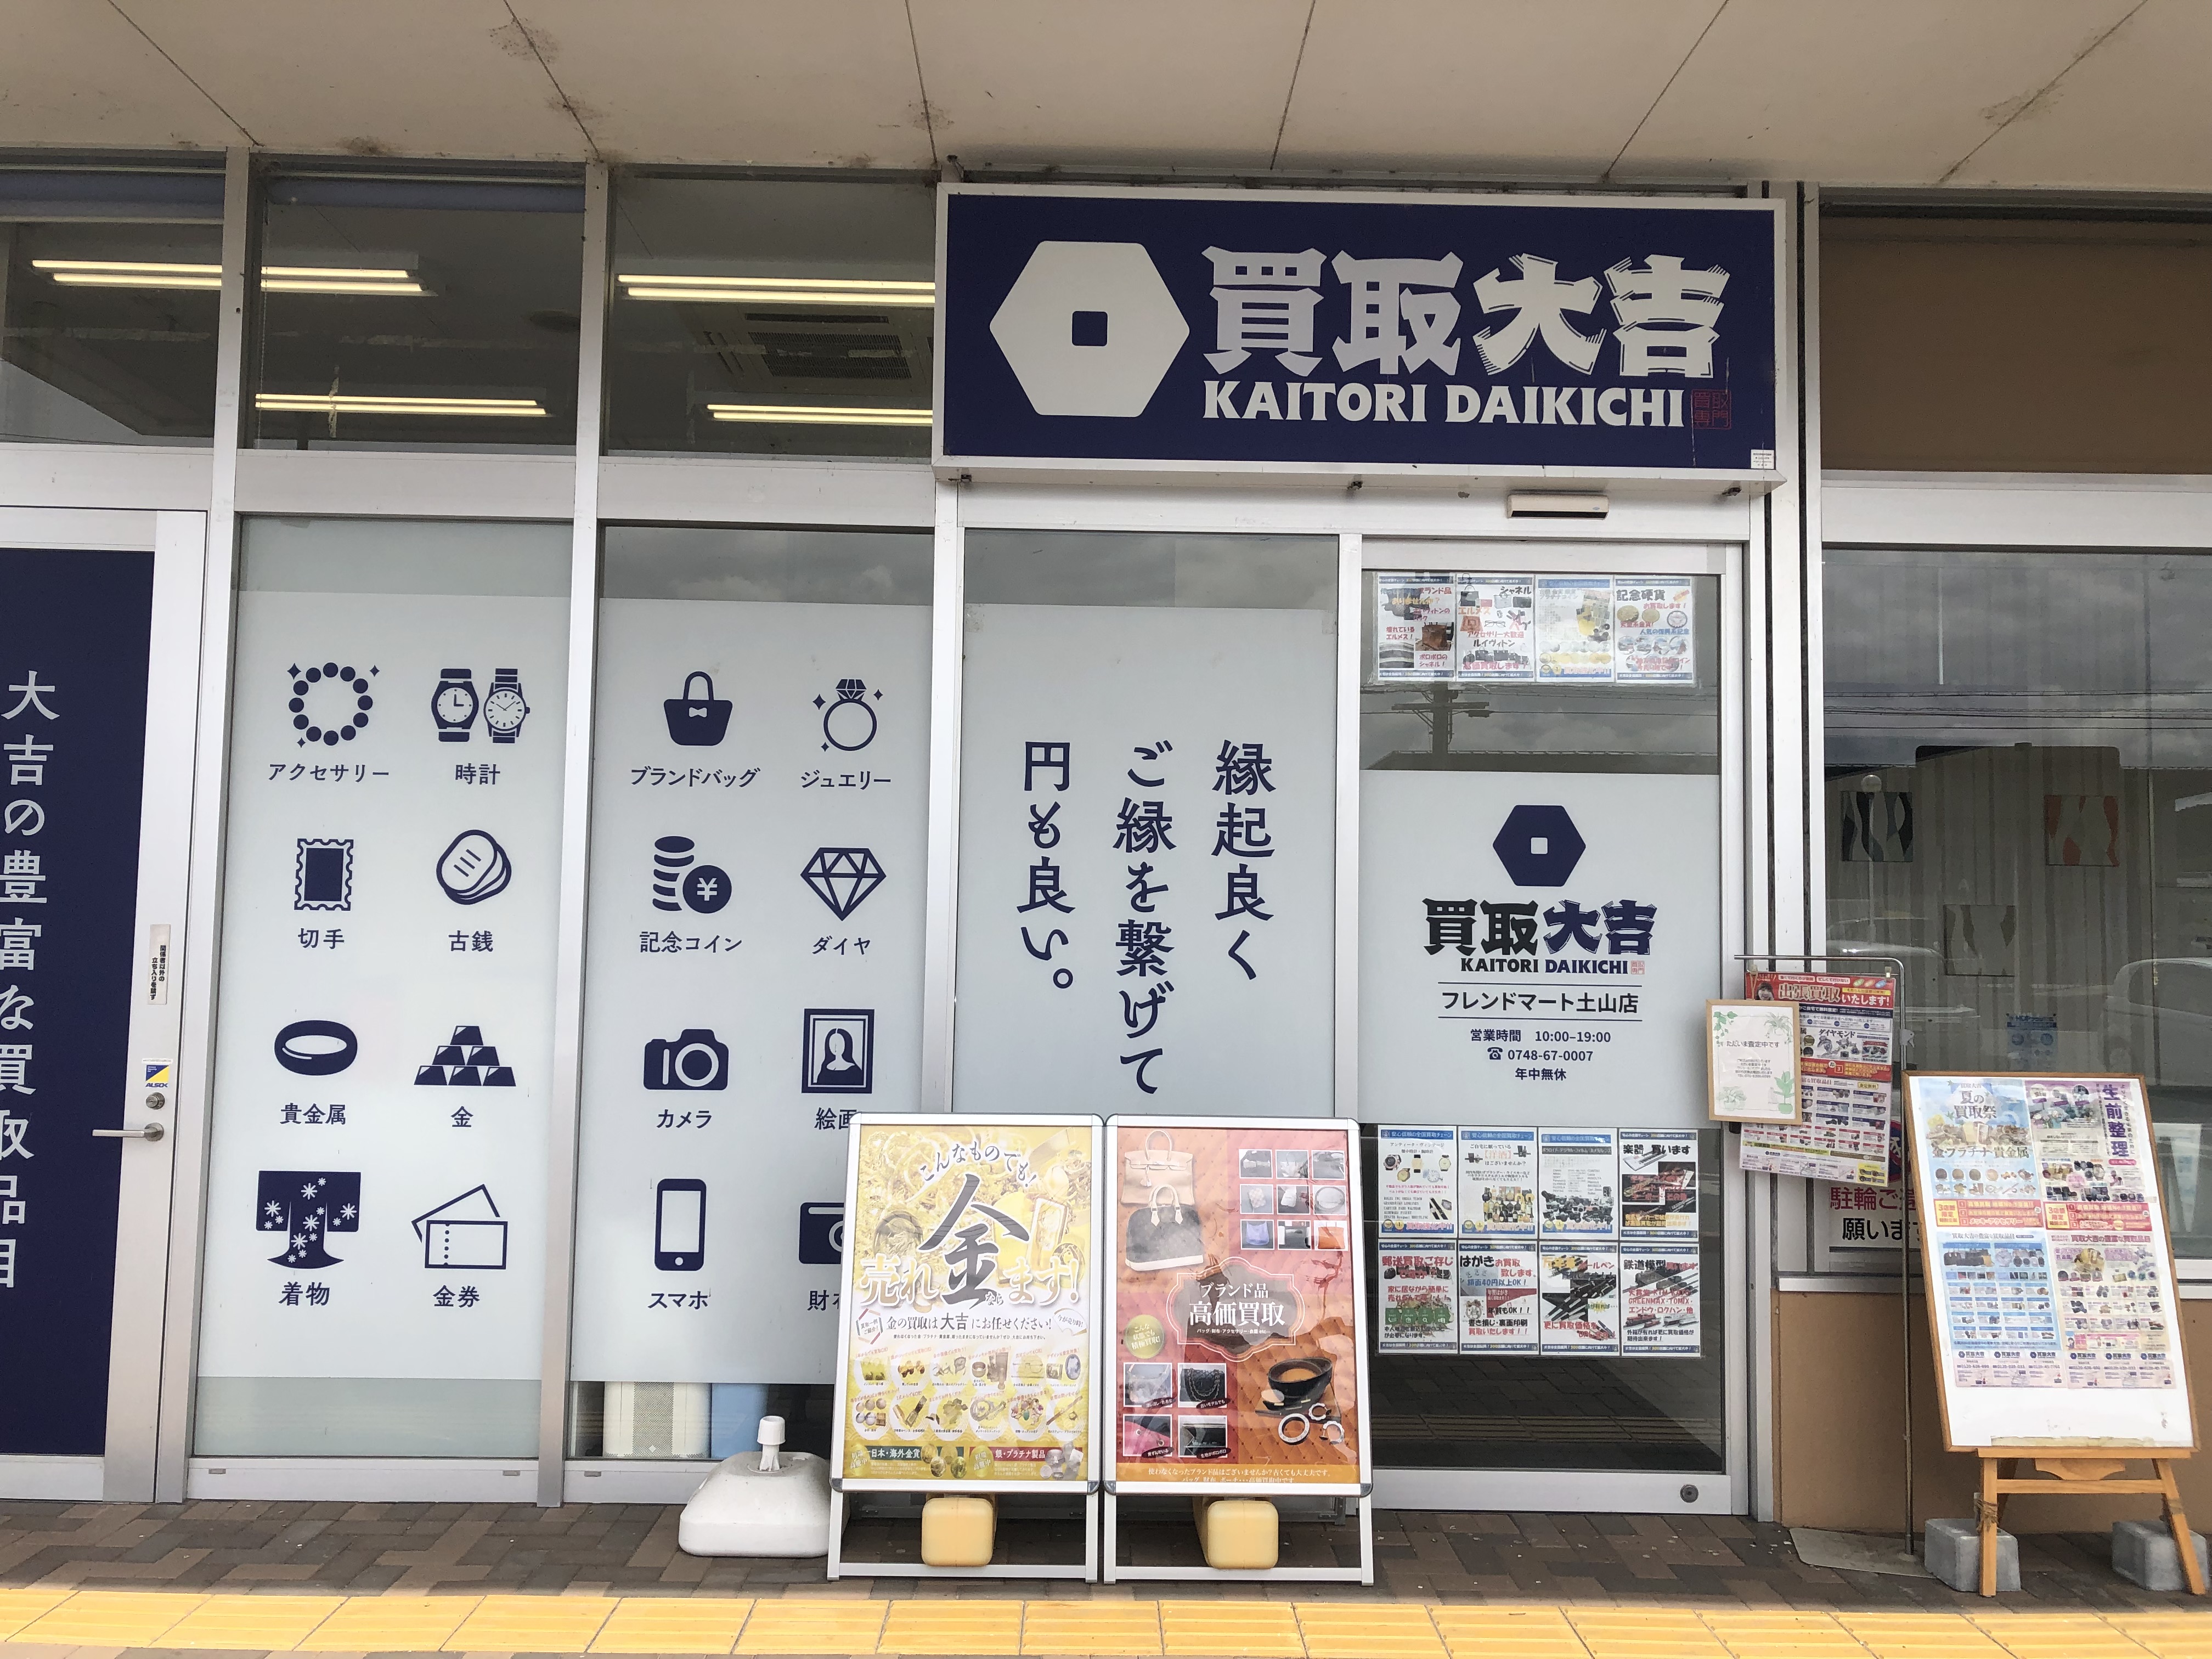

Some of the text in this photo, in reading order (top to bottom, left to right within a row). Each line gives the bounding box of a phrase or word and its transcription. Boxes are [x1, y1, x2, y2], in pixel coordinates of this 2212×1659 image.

[1201, 246, 1734, 379] 買取大吉
[1203, 380, 1685, 428] KAITORI DAIKICHI
[1499, 586, 1532, 595] シャネル
[1616, 589, 1666, 601] 記念硬貨
[268, 763, 390, 783] アクセサリー
[455, 763, 501, 785] 時計
[630, 765, 761, 787] ブランドバッグ
[800, 769, 892, 790] ジュエリー
[1016, 741, 1076, 990] 円も良い。
[1211, 739, 1277, 981] 縁起良く
[1112, 740, 1177, 1095] ご縁を繋げて
[1422, 898, 1658, 956] 買取大吉
[298, 928, 345, 949] 切手
[448, 930, 494, 952] 古銭
[639, 930, 743, 953] 記念コイン
[812, 936, 871, 955] ダイヤ
[1460, 957, 1628, 975] KAITORI DAIKICHI
[1441, 992, 1639, 1014] フレンドマート土山店
[1779, 983, 1841, 1002] 出張買取
[1842, 994, 1889, 1006] いたします!
[1470, 1029, 1522, 1042] 営業時間
[1819, 1029, 1855, 1038] ダイヤモンド
[1507, 1050, 1594, 1062] 0748-67-0007
[1515, 1068, 1567, 1081] 年中無休
[1960, 1091, 1984, 1104] 夏の
[280, 1102, 347, 1125] 貴金属
[451, 1105, 474, 1128] 金
[656, 1109, 713, 1129] カメラ
[1954, 1105, 1996, 1119] 買取祭
[2102, 1084, 2130, 1156] 生前整理
[1842, 1217, 1920, 1242] 願いま
[278, 1282, 330, 1306] 着物
[433, 1285, 481, 1307] 金券
[647, 1291, 709, 1310] スマホ
[1201, 1283, 1268, 1299] ブランド品
[1189, 1301, 1285, 1327] 高価買取
[871, 1448, 920, 1458] 日本・海外金貨
[995, 1449, 1046, 1459] 銀・プラチナ製品
